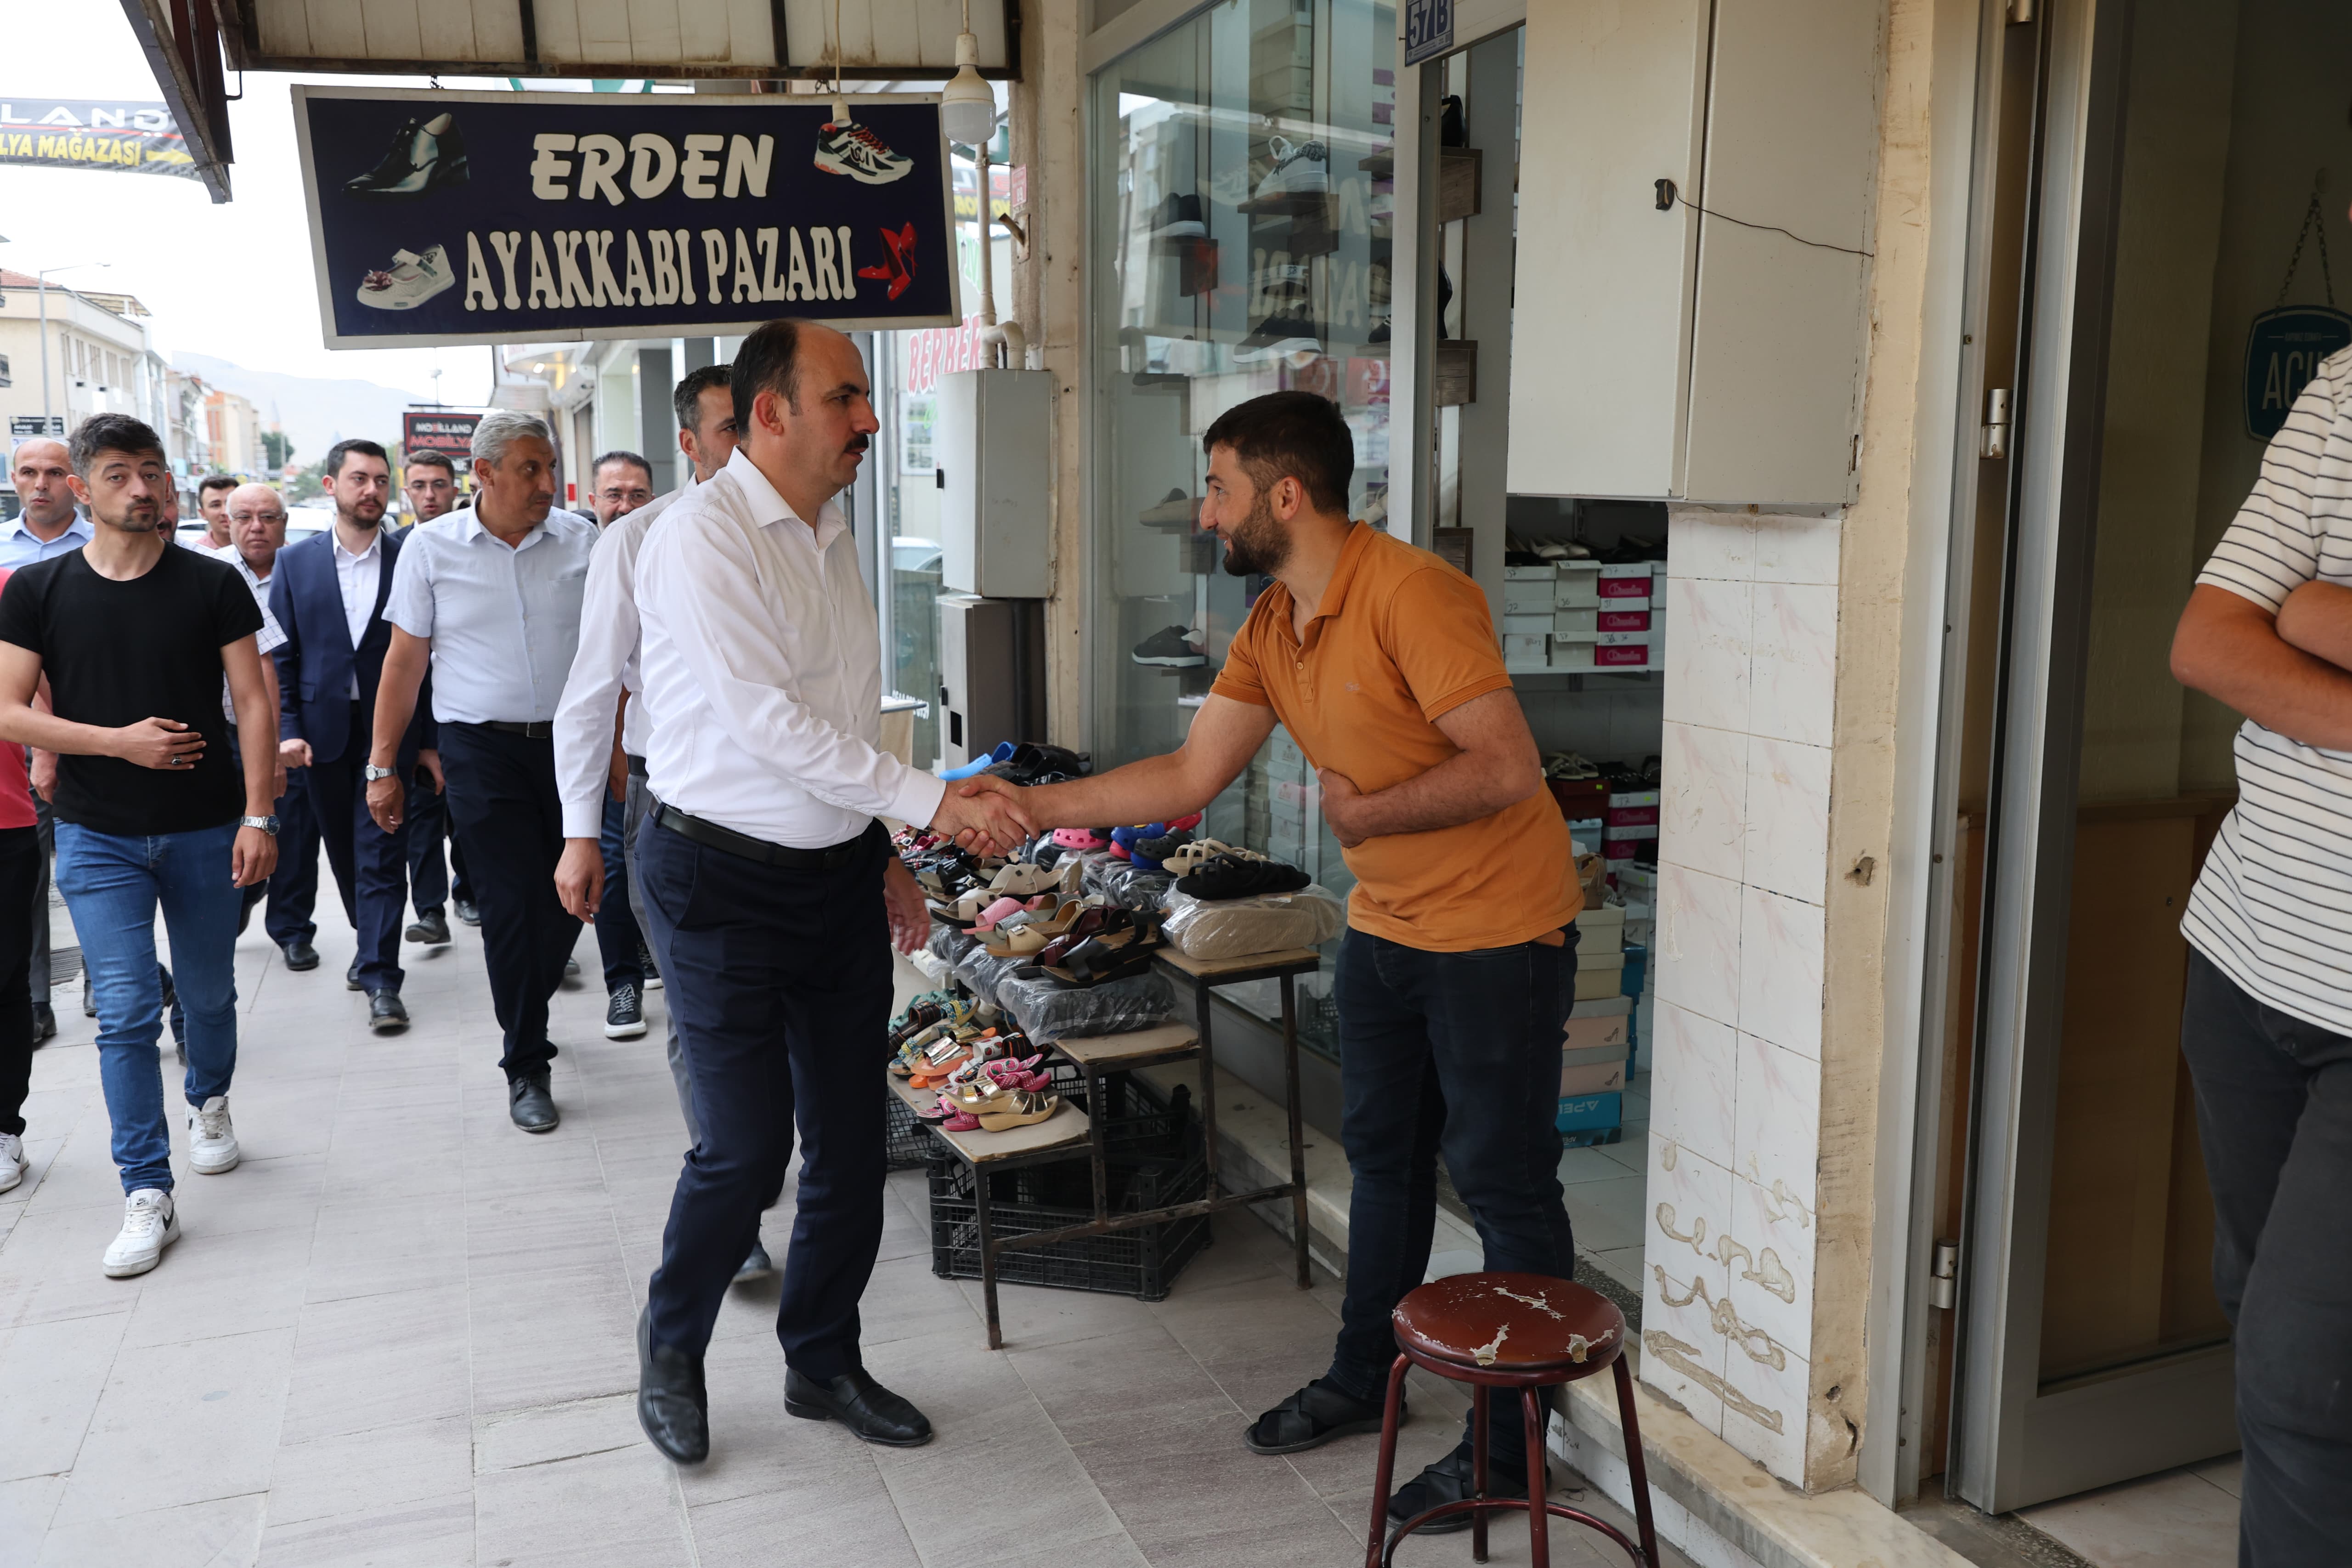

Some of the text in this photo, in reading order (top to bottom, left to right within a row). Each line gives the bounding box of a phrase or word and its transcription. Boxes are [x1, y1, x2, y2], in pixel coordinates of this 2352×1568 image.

[37, 132, 142, 166] MAĞAZASI
[530, 133, 774, 205] ERDEN
[464, 225, 858, 311] AYAKKABI PAZARI
